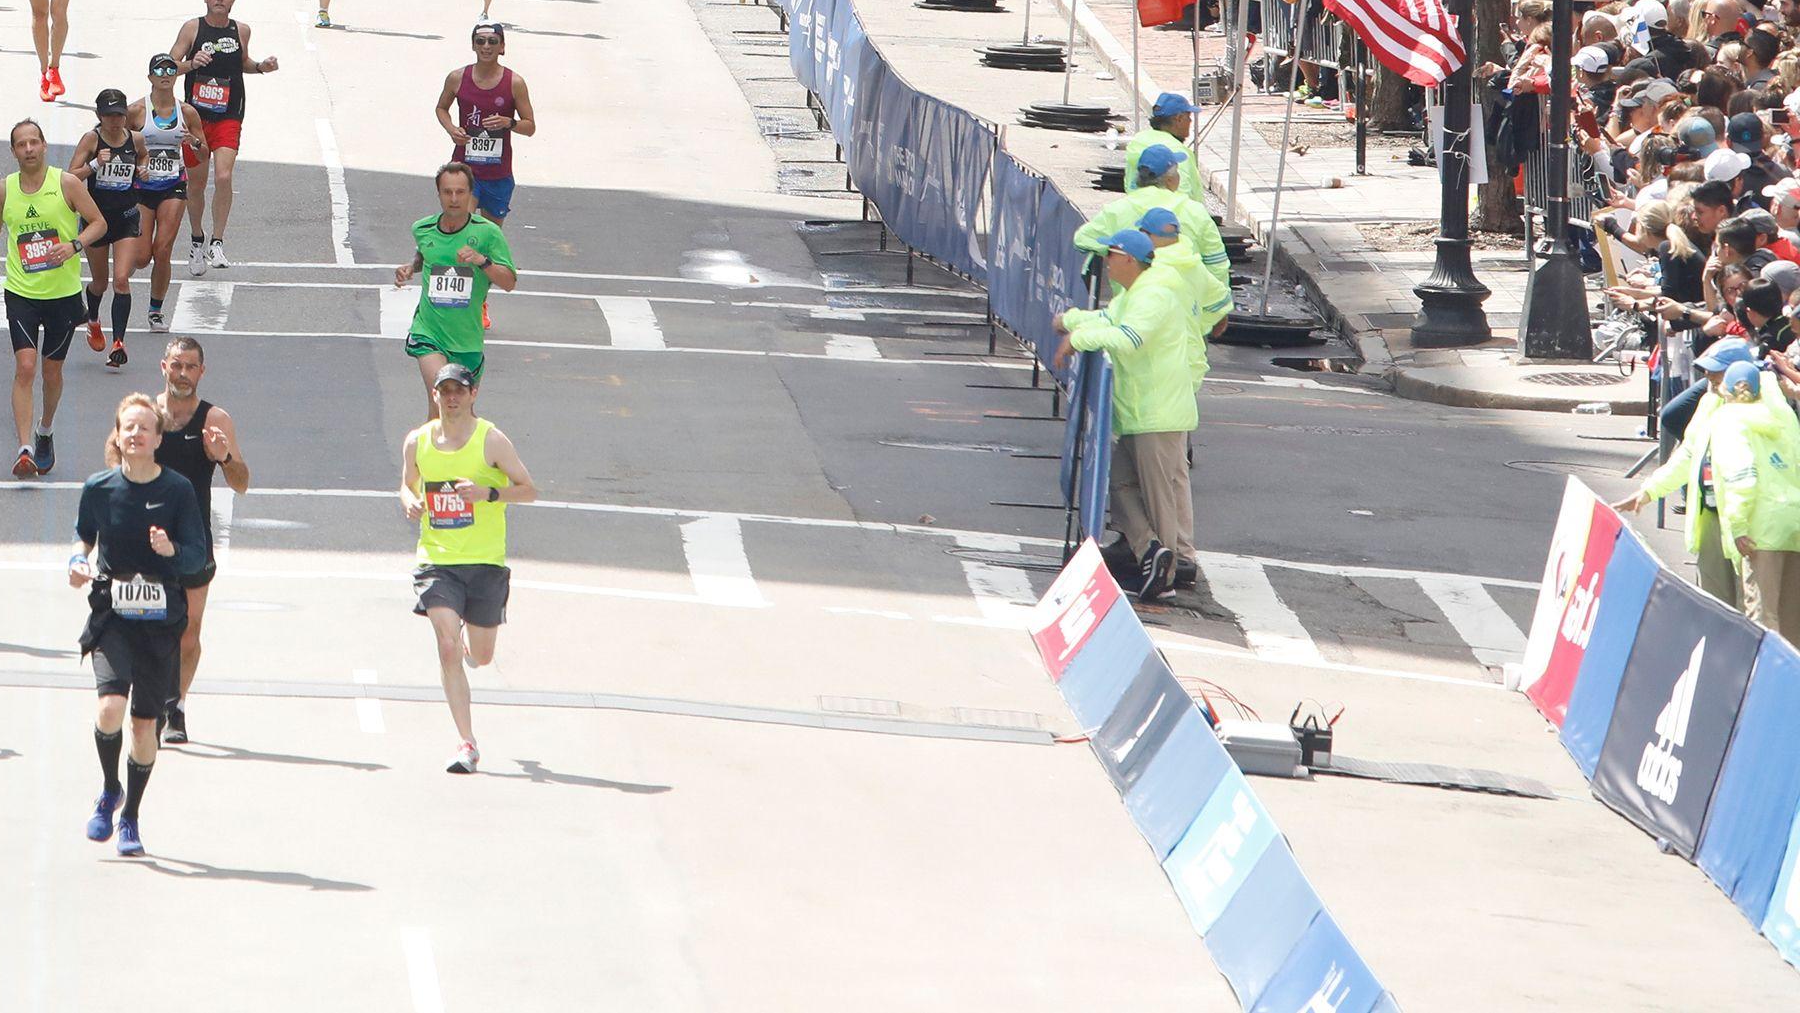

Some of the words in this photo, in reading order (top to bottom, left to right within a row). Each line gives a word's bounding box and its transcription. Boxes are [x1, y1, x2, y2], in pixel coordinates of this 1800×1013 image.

[196, 85, 224, 100] 6963
[471, 137, 497, 152] 8397
[100, 161, 132, 178] 11455
[148, 156, 173, 172] 9386
[19, 222, 50, 234] STEVE
[436, 275, 465, 293] 8140
[433, 493, 466, 514] 6755
[117, 582, 161, 603] 10705
